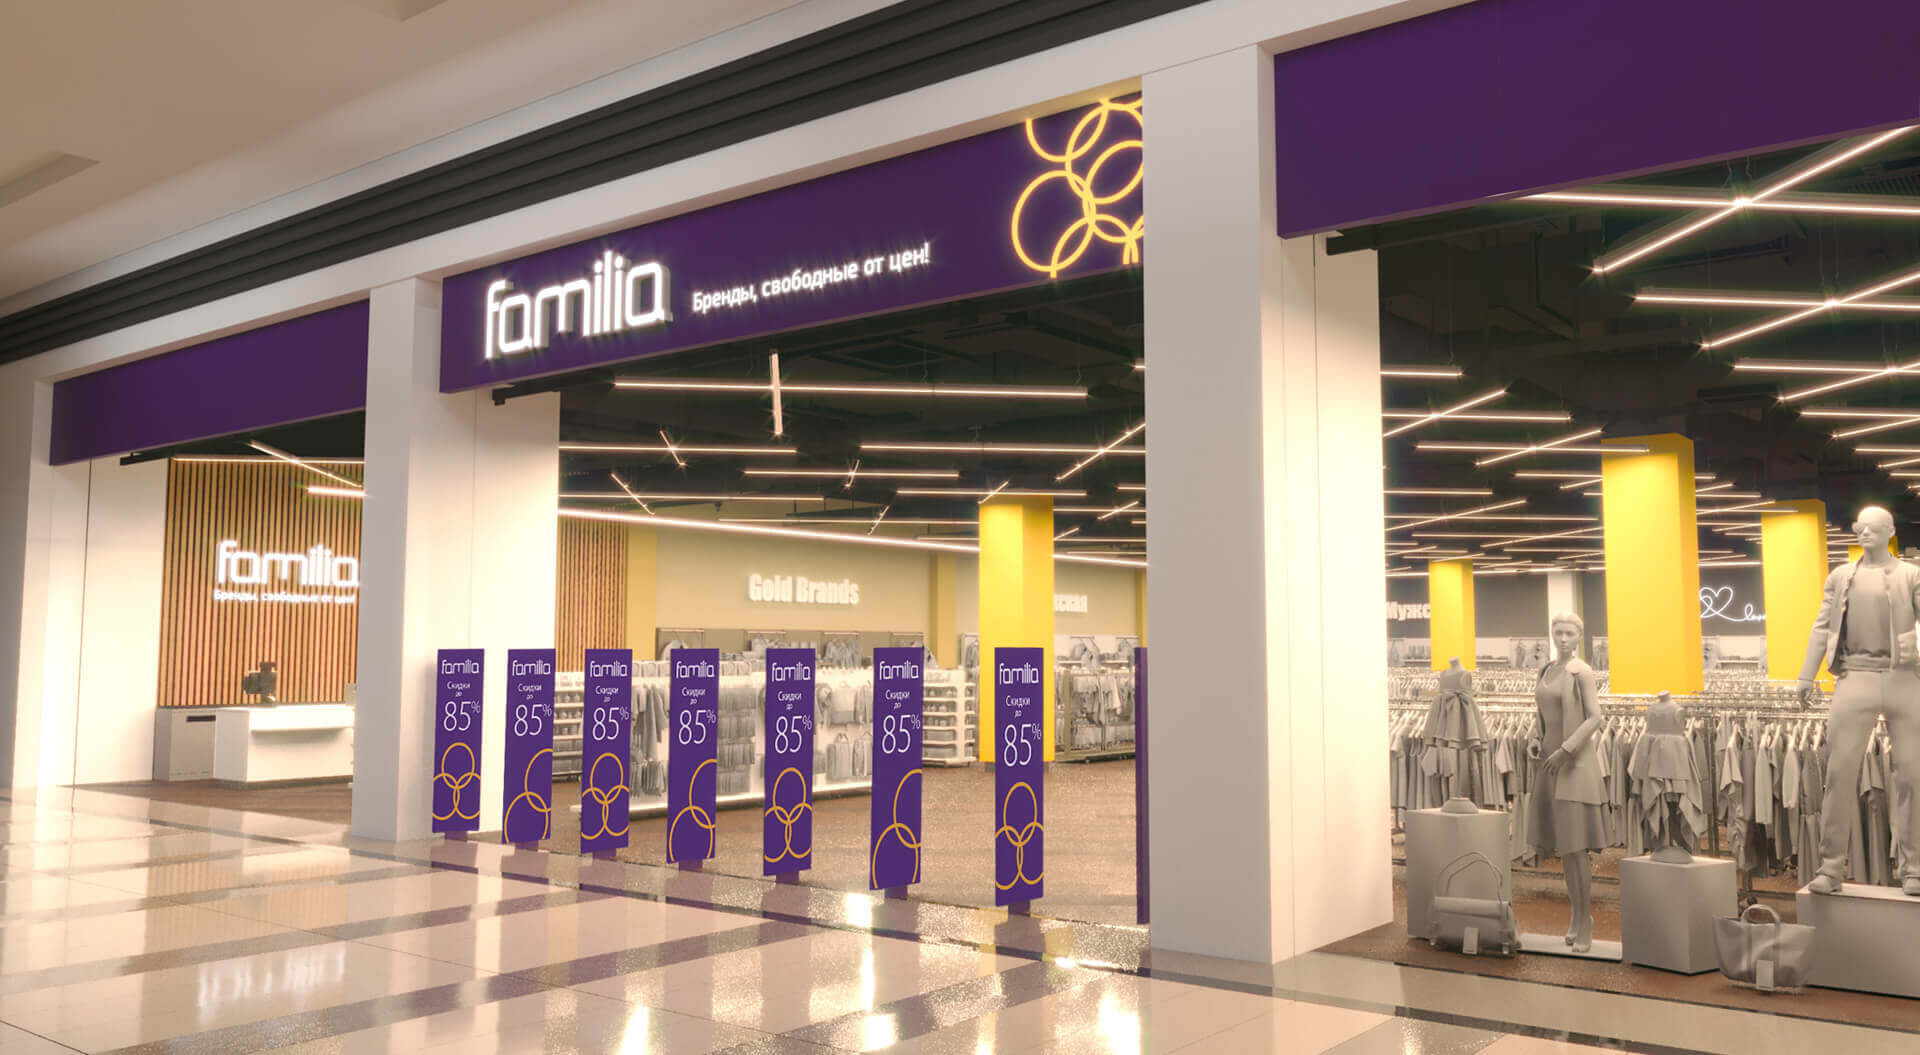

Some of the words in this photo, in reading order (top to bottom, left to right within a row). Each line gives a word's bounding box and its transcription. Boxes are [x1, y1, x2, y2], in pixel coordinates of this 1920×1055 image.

[691, 283, 758, 315] Бренды,
[761, 261, 858, 297] свободные
[863, 255, 885, 277] от
[889, 241, 931, 273] цен!
[485, 250, 672, 359] familia
[216, 539, 360, 588] familia
[748, 573, 793, 603] Gold
[795, 576, 860, 605] Brands
[441, 659, 480, 675] familia
[511, 659, 551, 676] familia
[589, 660, 628, 678] familia
[675, 660, 715, 679] familia
[771, 661, 811, 682] familia
[879, 660, 919, 681] familia
[999, 662, 1040, 685] familia
[777, 690, 802, 702] Скидки
[885, 689, 910, 701] Скидки
[1005, 695, 1031, 708] Скидки
[443, 700, 481, 731] 85%
[513, 703, 552, 736] 85%
[592, 706, 630, 741] 85%
[678, 709, 717, 745] 85%
[774, 714, 813, 754] 85%
[881, 713, 921, 755] 85%
[1003, 722, 1042, 767] 85%
